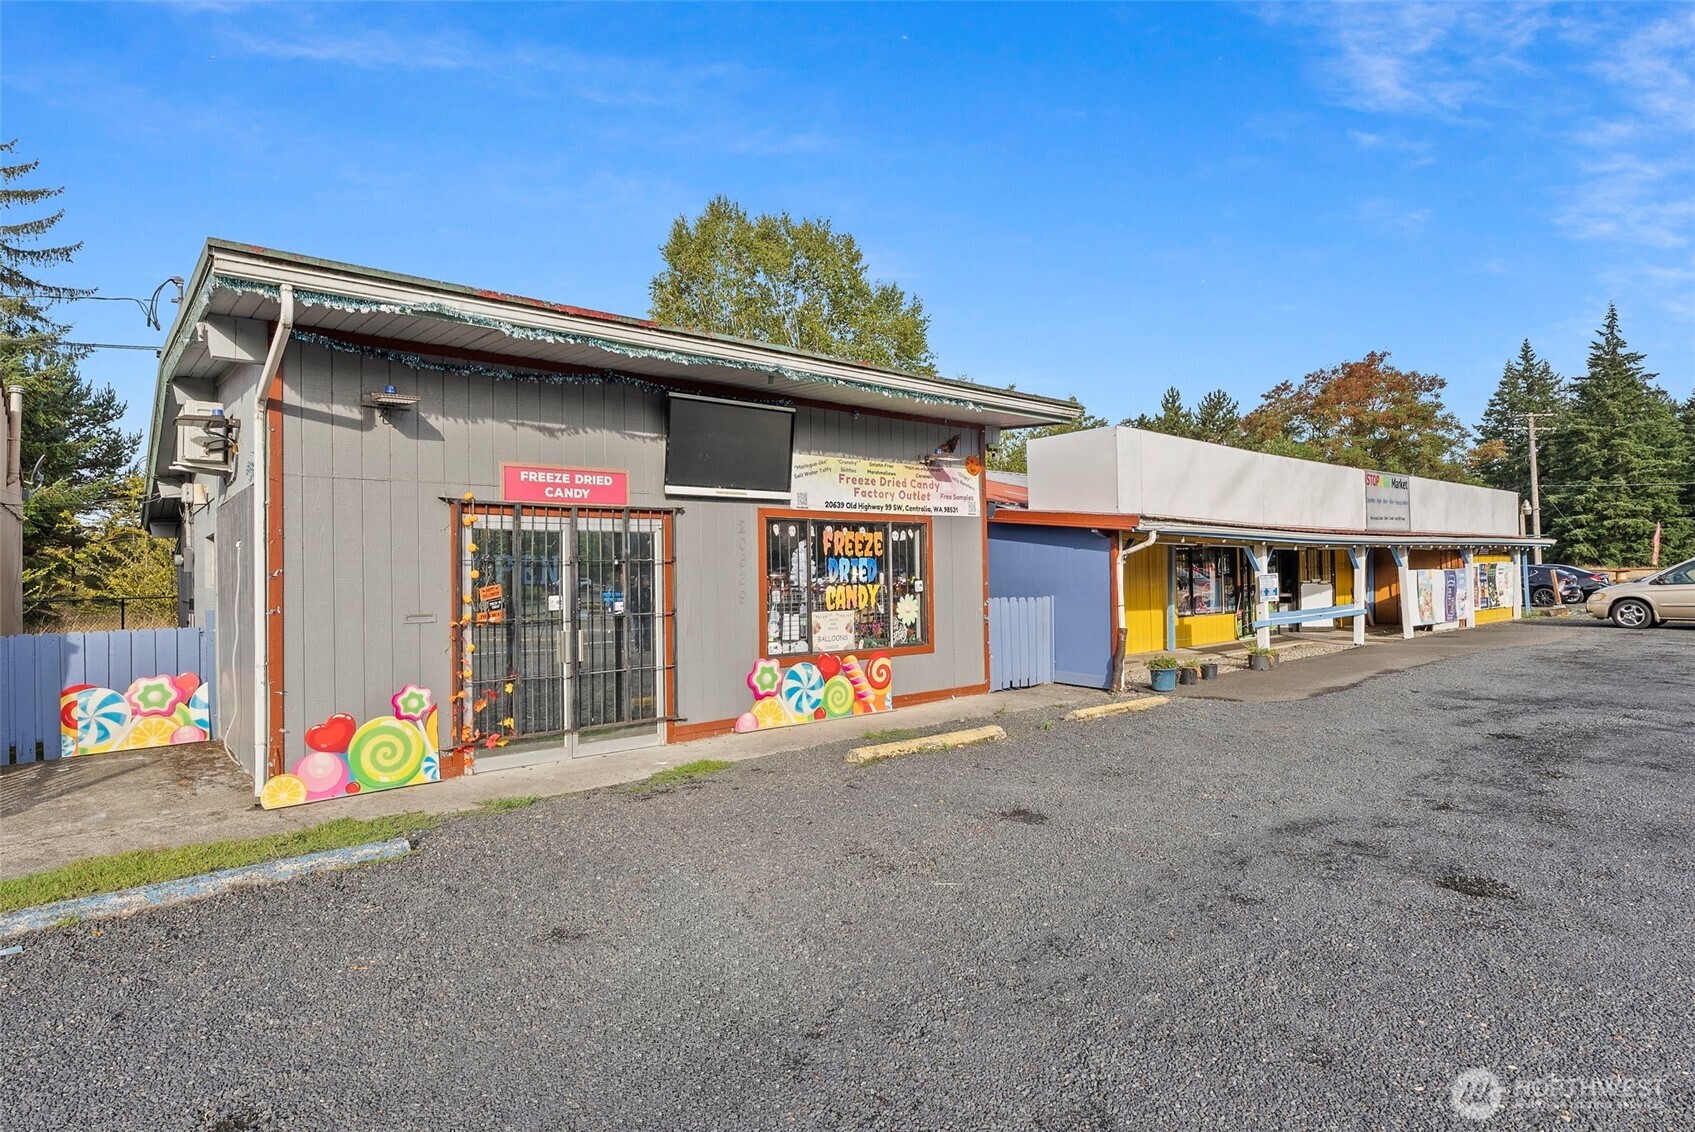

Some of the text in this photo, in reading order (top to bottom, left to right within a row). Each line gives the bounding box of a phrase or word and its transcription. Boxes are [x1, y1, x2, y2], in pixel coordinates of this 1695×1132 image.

[520, 471, 613, 486] FREEZE DRIED
[867, 469, 897, 477] Marshmallows
[838, 474, 940, 493] Freeze Dried Candy
[1366, 473, 1380, 487] STOP
[1391, 477, 1408, 490] Market
[545, 487, 590, 499] CANDY
[853, 487, 931, 502] Factory Outlet
[953, 494, 974, 502] Samples
[824, 500, 845, 509] 20639
[845, 501, 857, 509] Old
[858, 502, 884, 512] Highway
[884, 503, 892, 511] 99
[893, 504, 905, 512] SW,
[905, 505, 933, 514] Centralia,
[944, 506, 959, 514] 98531
[822, 530, 883, 557] FREEZE
[827, 557, 877, 584] DRIED
[825, 584, 881, 611] CANDY
[818, 634, 849, 643] BALLOONS
